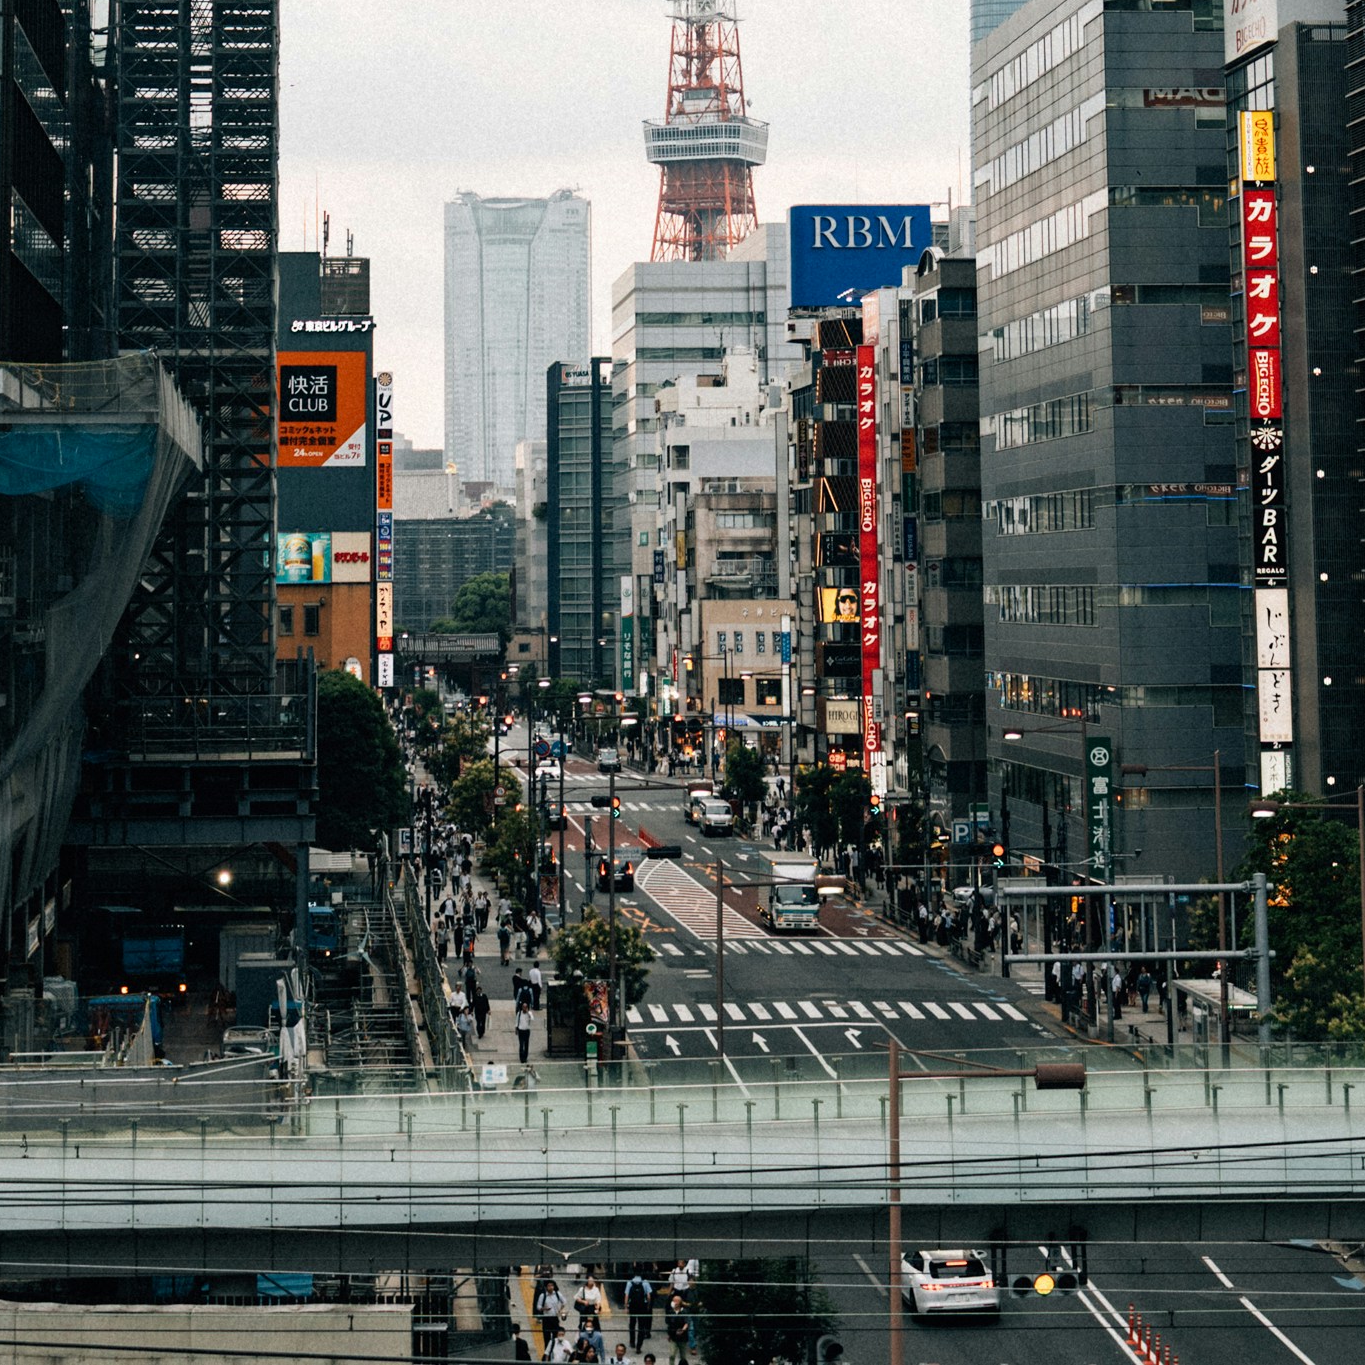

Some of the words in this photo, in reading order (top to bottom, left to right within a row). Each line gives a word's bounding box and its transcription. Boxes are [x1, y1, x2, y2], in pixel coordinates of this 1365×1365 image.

[811, 215, 914, 249] RBM
[1247, 198, 1277, 337] カラオケ
[305, 320, 371, 333] 東京ビルグループ
[288, 375, 329, 395] 快活
[288, 398, 329, 412] CLUB
[859, 365, 874, 429] カラオケ
[1259, 455, 1280, 505] ダーツ
[1262, 508, 1278, 563] BAR
[863, 580, 878, 646] カラオケ
[623, 632, 632, 678] りそな銀行
